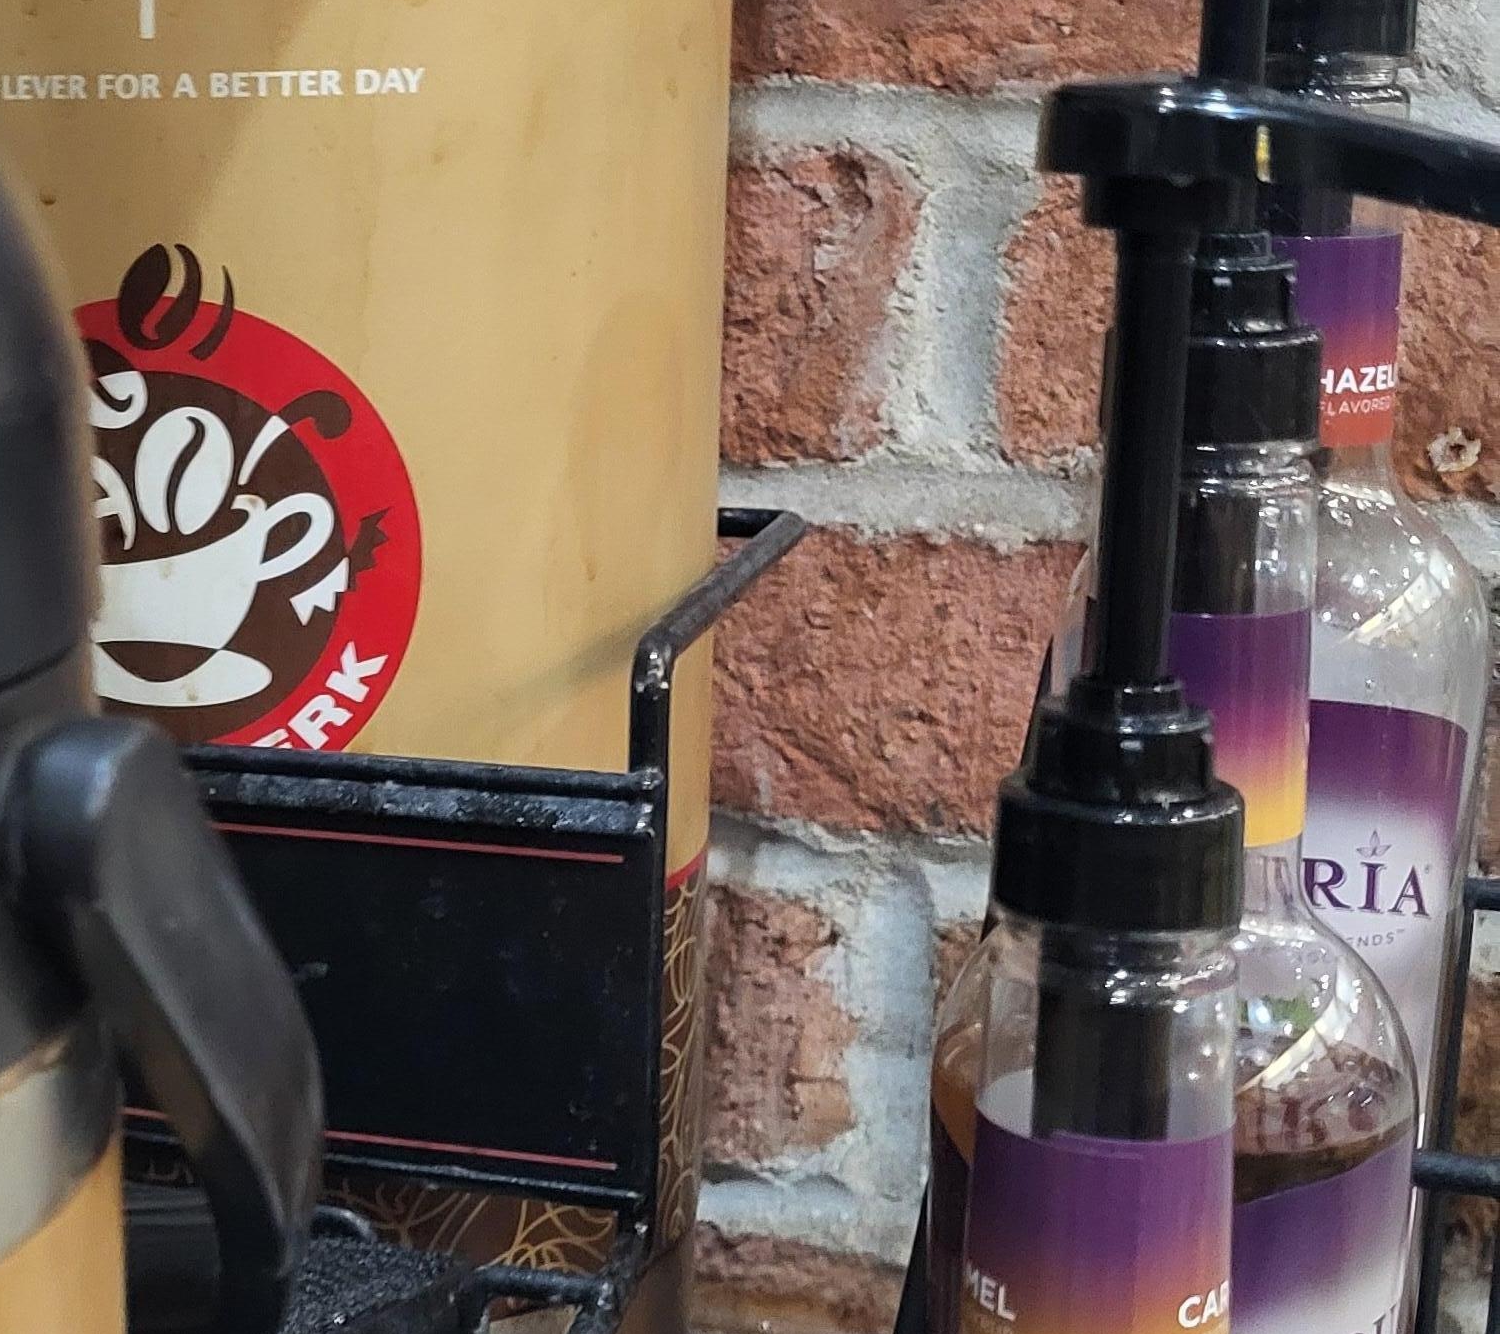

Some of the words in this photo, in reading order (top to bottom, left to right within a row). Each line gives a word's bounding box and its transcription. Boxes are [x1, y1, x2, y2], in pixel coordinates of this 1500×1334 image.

[2, 74, 87, 101] LEVER
[97, 72, 161, 99] FOR
[172, 71, 197, 98] A
[209, 69, 342, 98] BETTER
[355, 67, 424, 95] DAY
